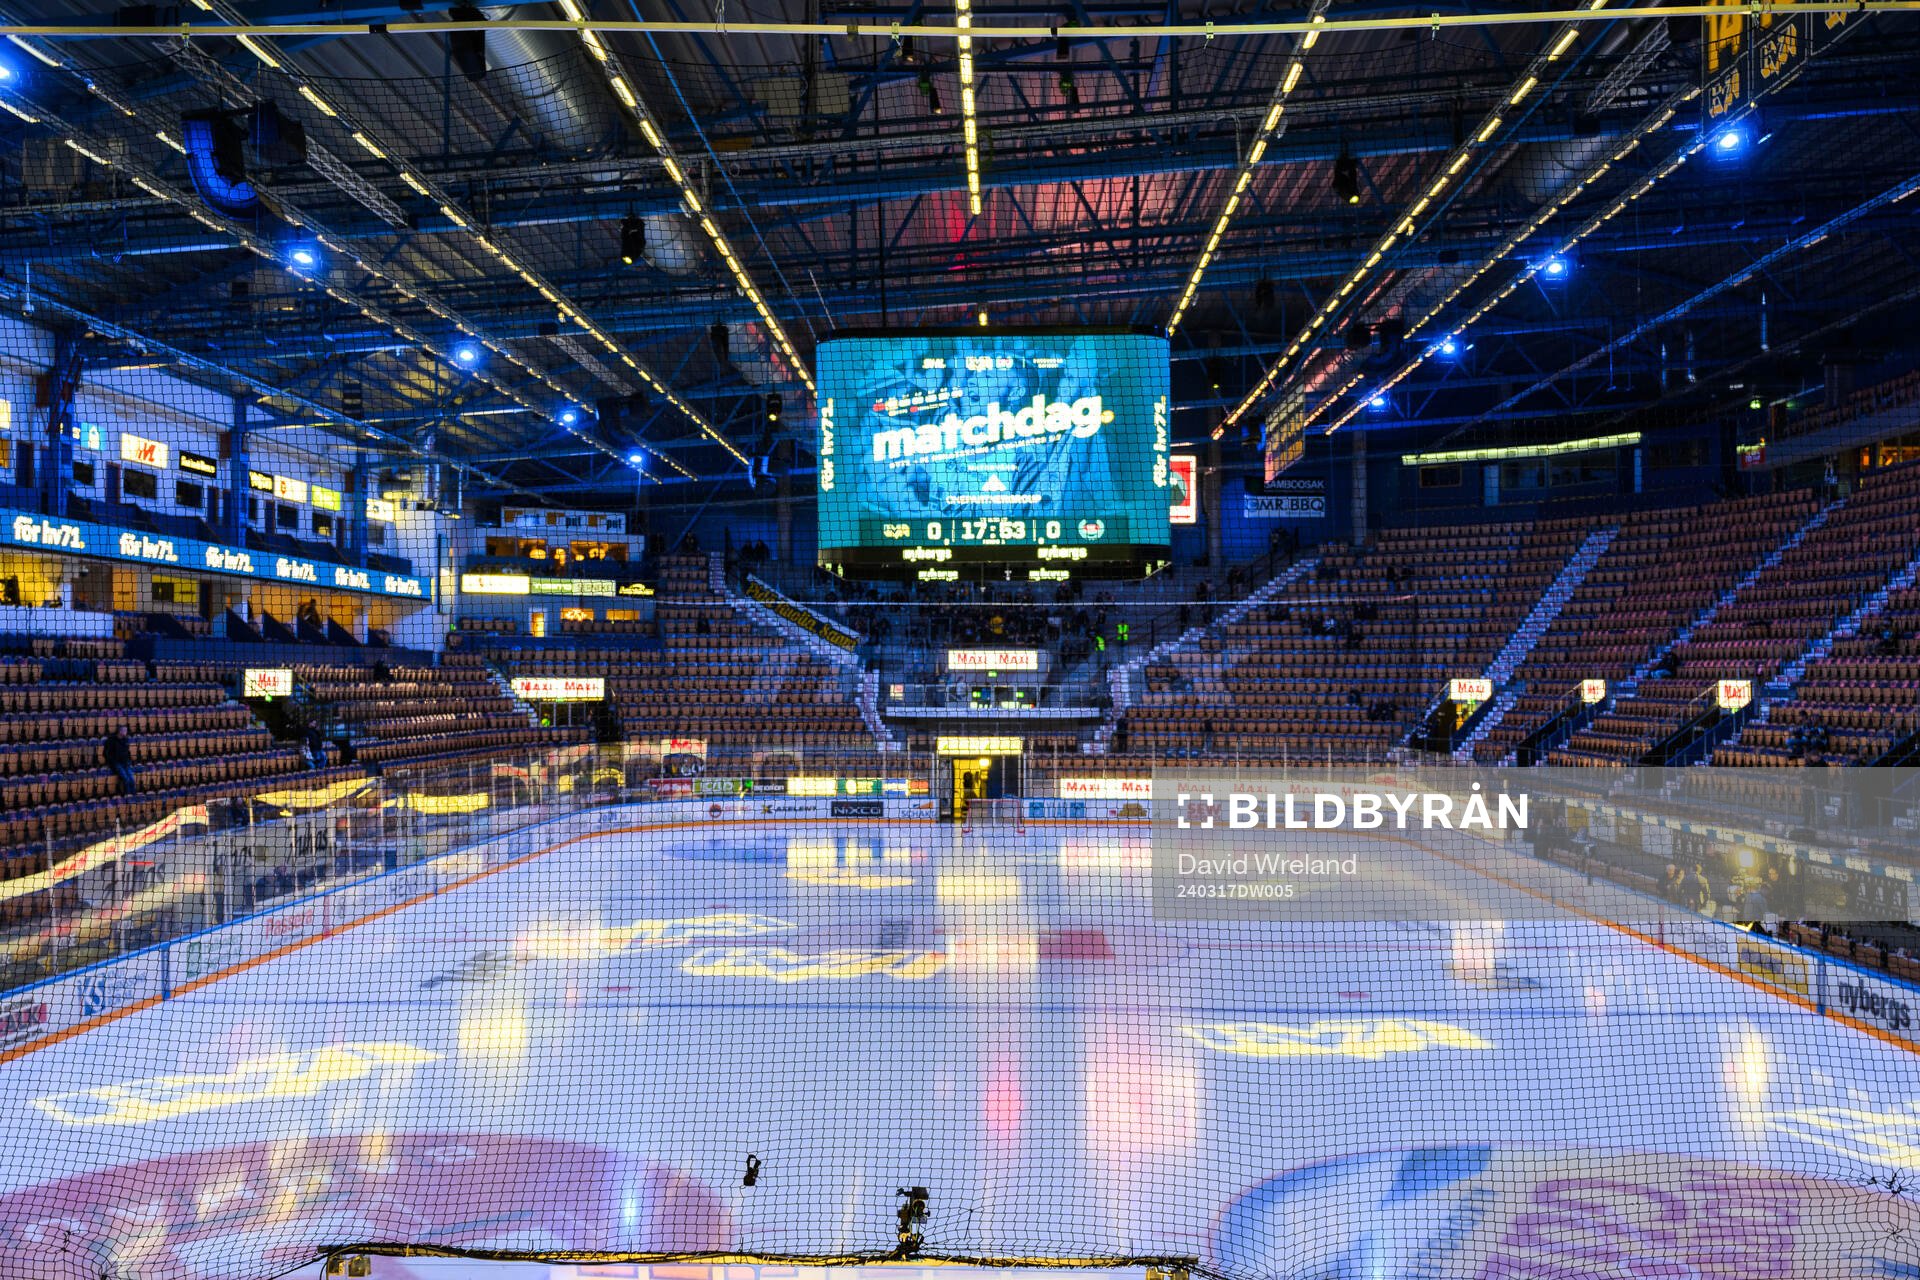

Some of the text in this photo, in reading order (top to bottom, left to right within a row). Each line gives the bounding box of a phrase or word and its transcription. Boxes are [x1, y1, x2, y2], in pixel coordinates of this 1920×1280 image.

[1290, 498, 1325, 512] BBQ
[14, 516, 41, 543] för
[927, 521, 941, 540] 0
[1046, 521, 1060, 540] 0
[120, 532, 142, 557] för
[206, 546, 224, 568] för
